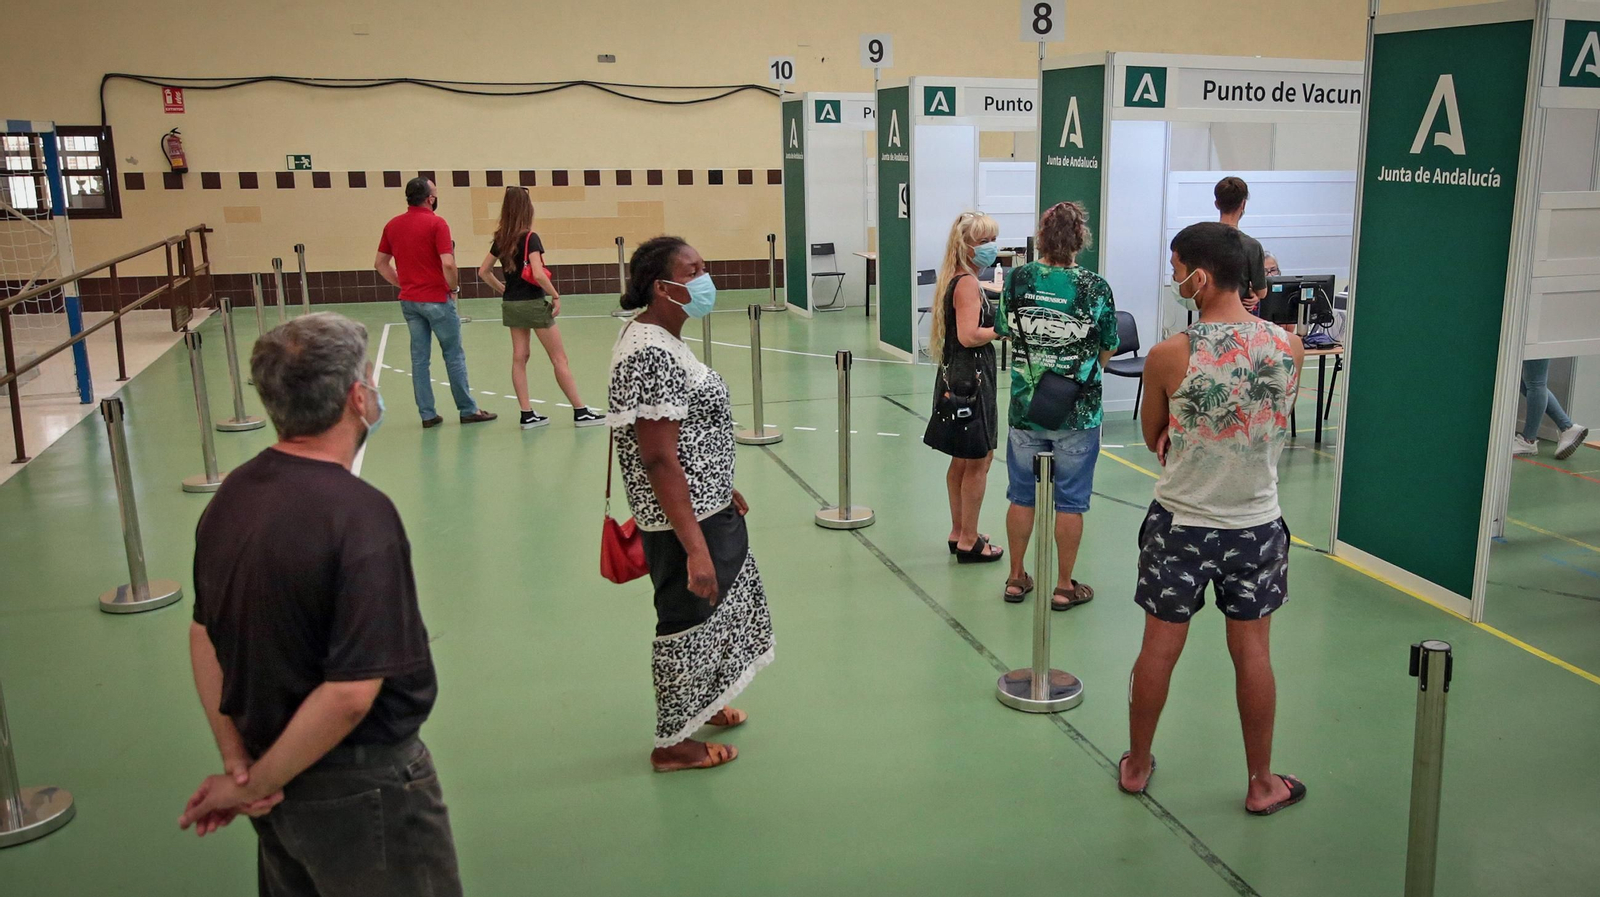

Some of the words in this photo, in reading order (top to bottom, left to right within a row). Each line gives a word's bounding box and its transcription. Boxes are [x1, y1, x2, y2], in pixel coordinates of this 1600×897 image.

[1032, 2, 1053, 35] 8
[868, 39, 884, 63] 9
[770, 60, 793, 80] 10
[1202, 80, 1266, 102] Punto
[1271, 81, 1296, 102] de
[1302, 83, 1361, 104] Vacun
[984, 96, 1034, 112] Punto
[1046, 154, 1062, 166] Junta
[1062, 155, 1070, 167] de
[1070, 155, 1098, 169] Andalucía
[1377, 165, 1412, 182] Junta
[1414, 166, 1431, 183] de
[1432, 167, 1501, 188] Andalucía
